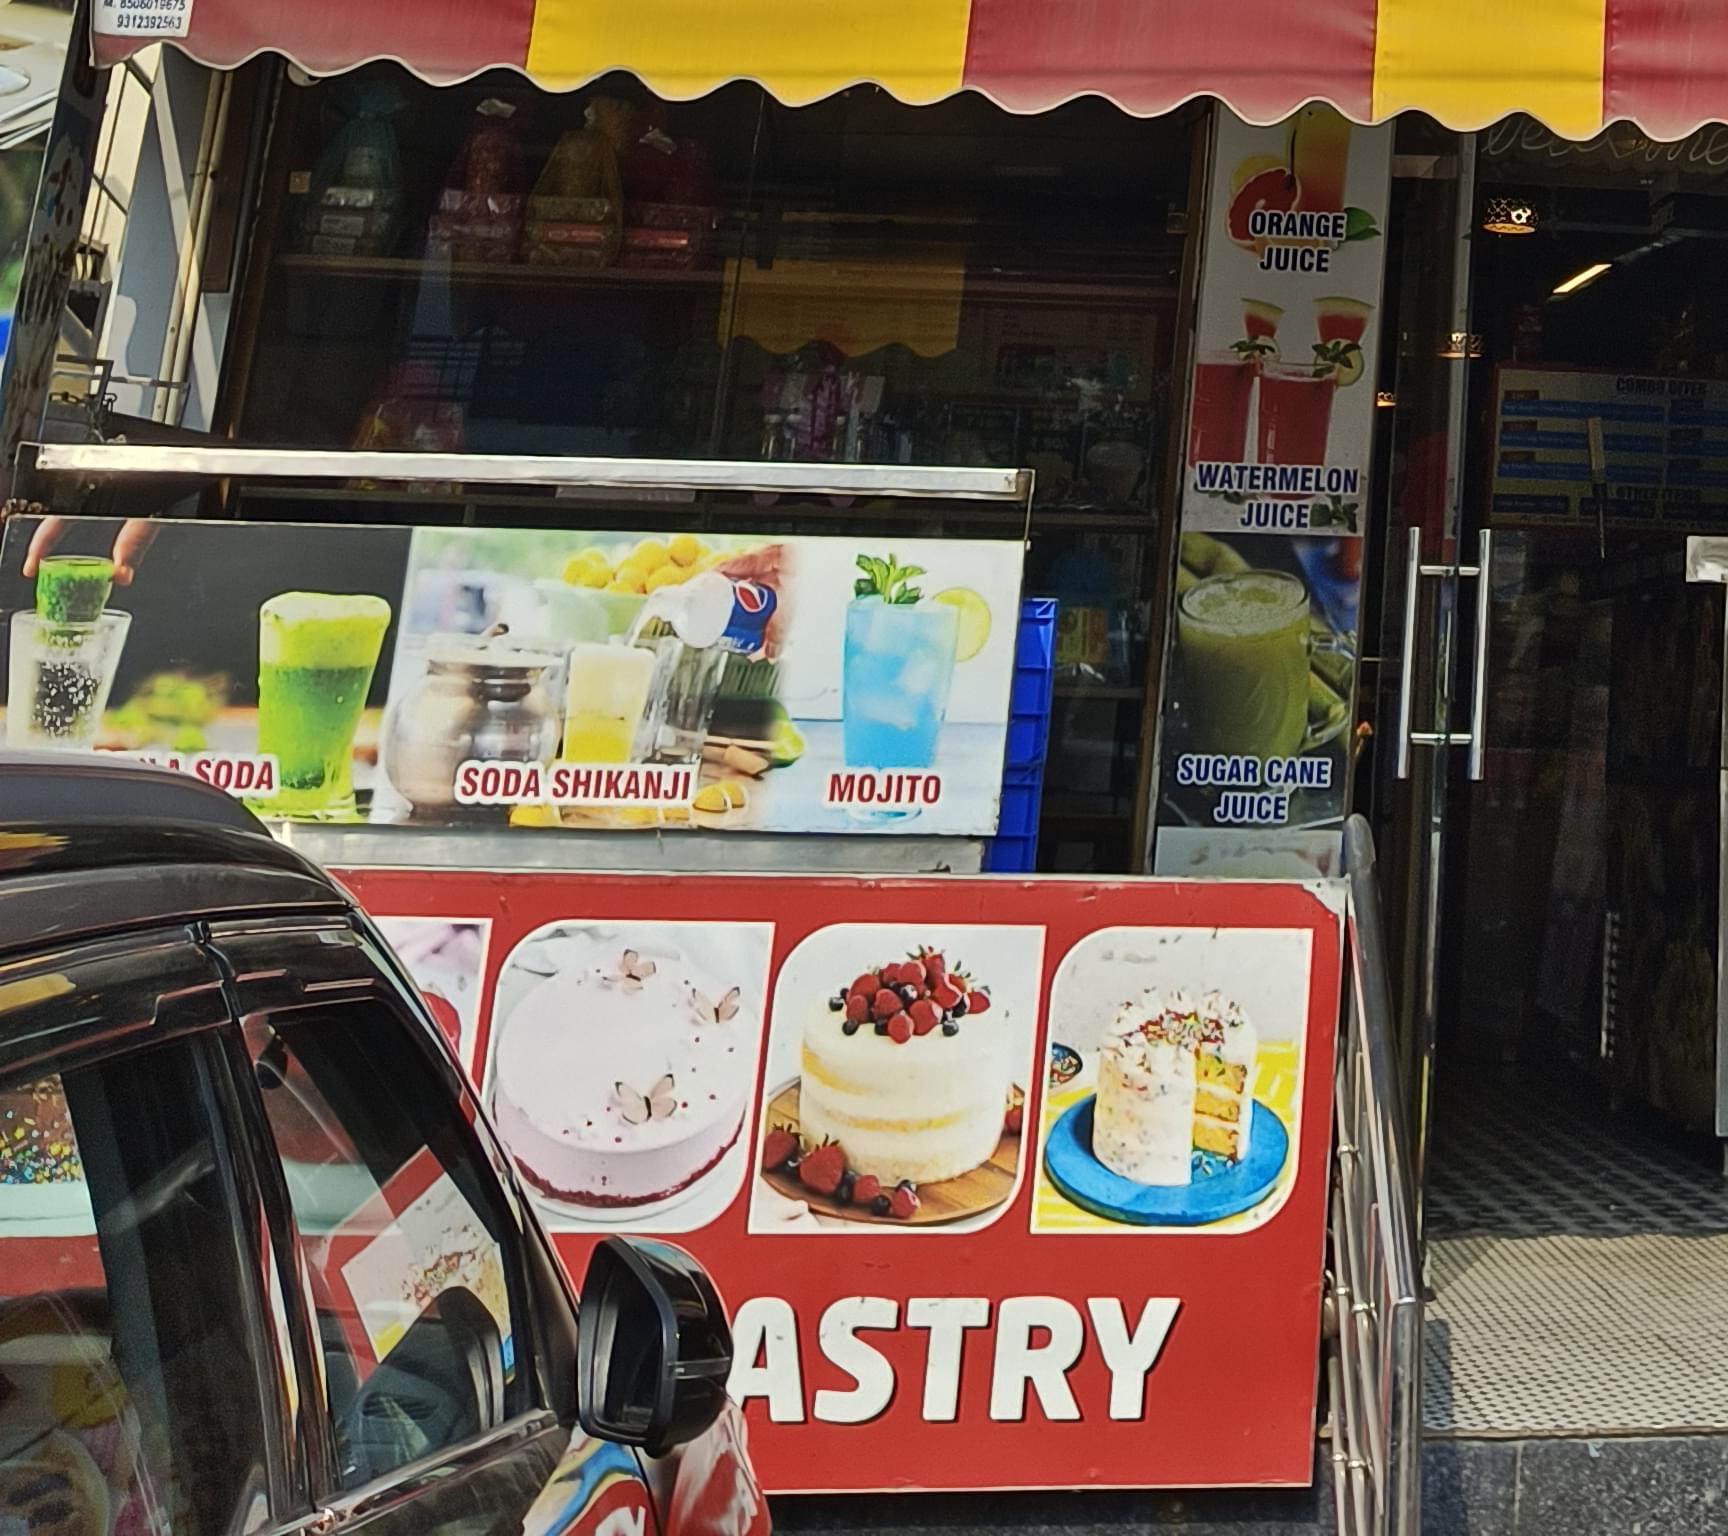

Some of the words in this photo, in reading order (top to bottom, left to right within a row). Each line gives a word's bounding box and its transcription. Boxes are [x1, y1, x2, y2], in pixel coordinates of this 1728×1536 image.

[1249, 211, 1347, 239] ORANGE
[1258, 246, 1331, 273] JUICE
[1197, 464, 1359, 494] WATERMELON
[1240, 500, 1311, 529] JUICE
[461, 766, 541, 799] SODA
[552, 770, 693, 803] SHIKANJI
[1177, 755, 1261, 785] SUGAR
[1266, 758, 1332, 788] CANE
[829, 774, 942, 805] MOJITO
[1213, 793, 1290, 824] JUICE
[728, 1295, 1181, 1426] ASTRY
